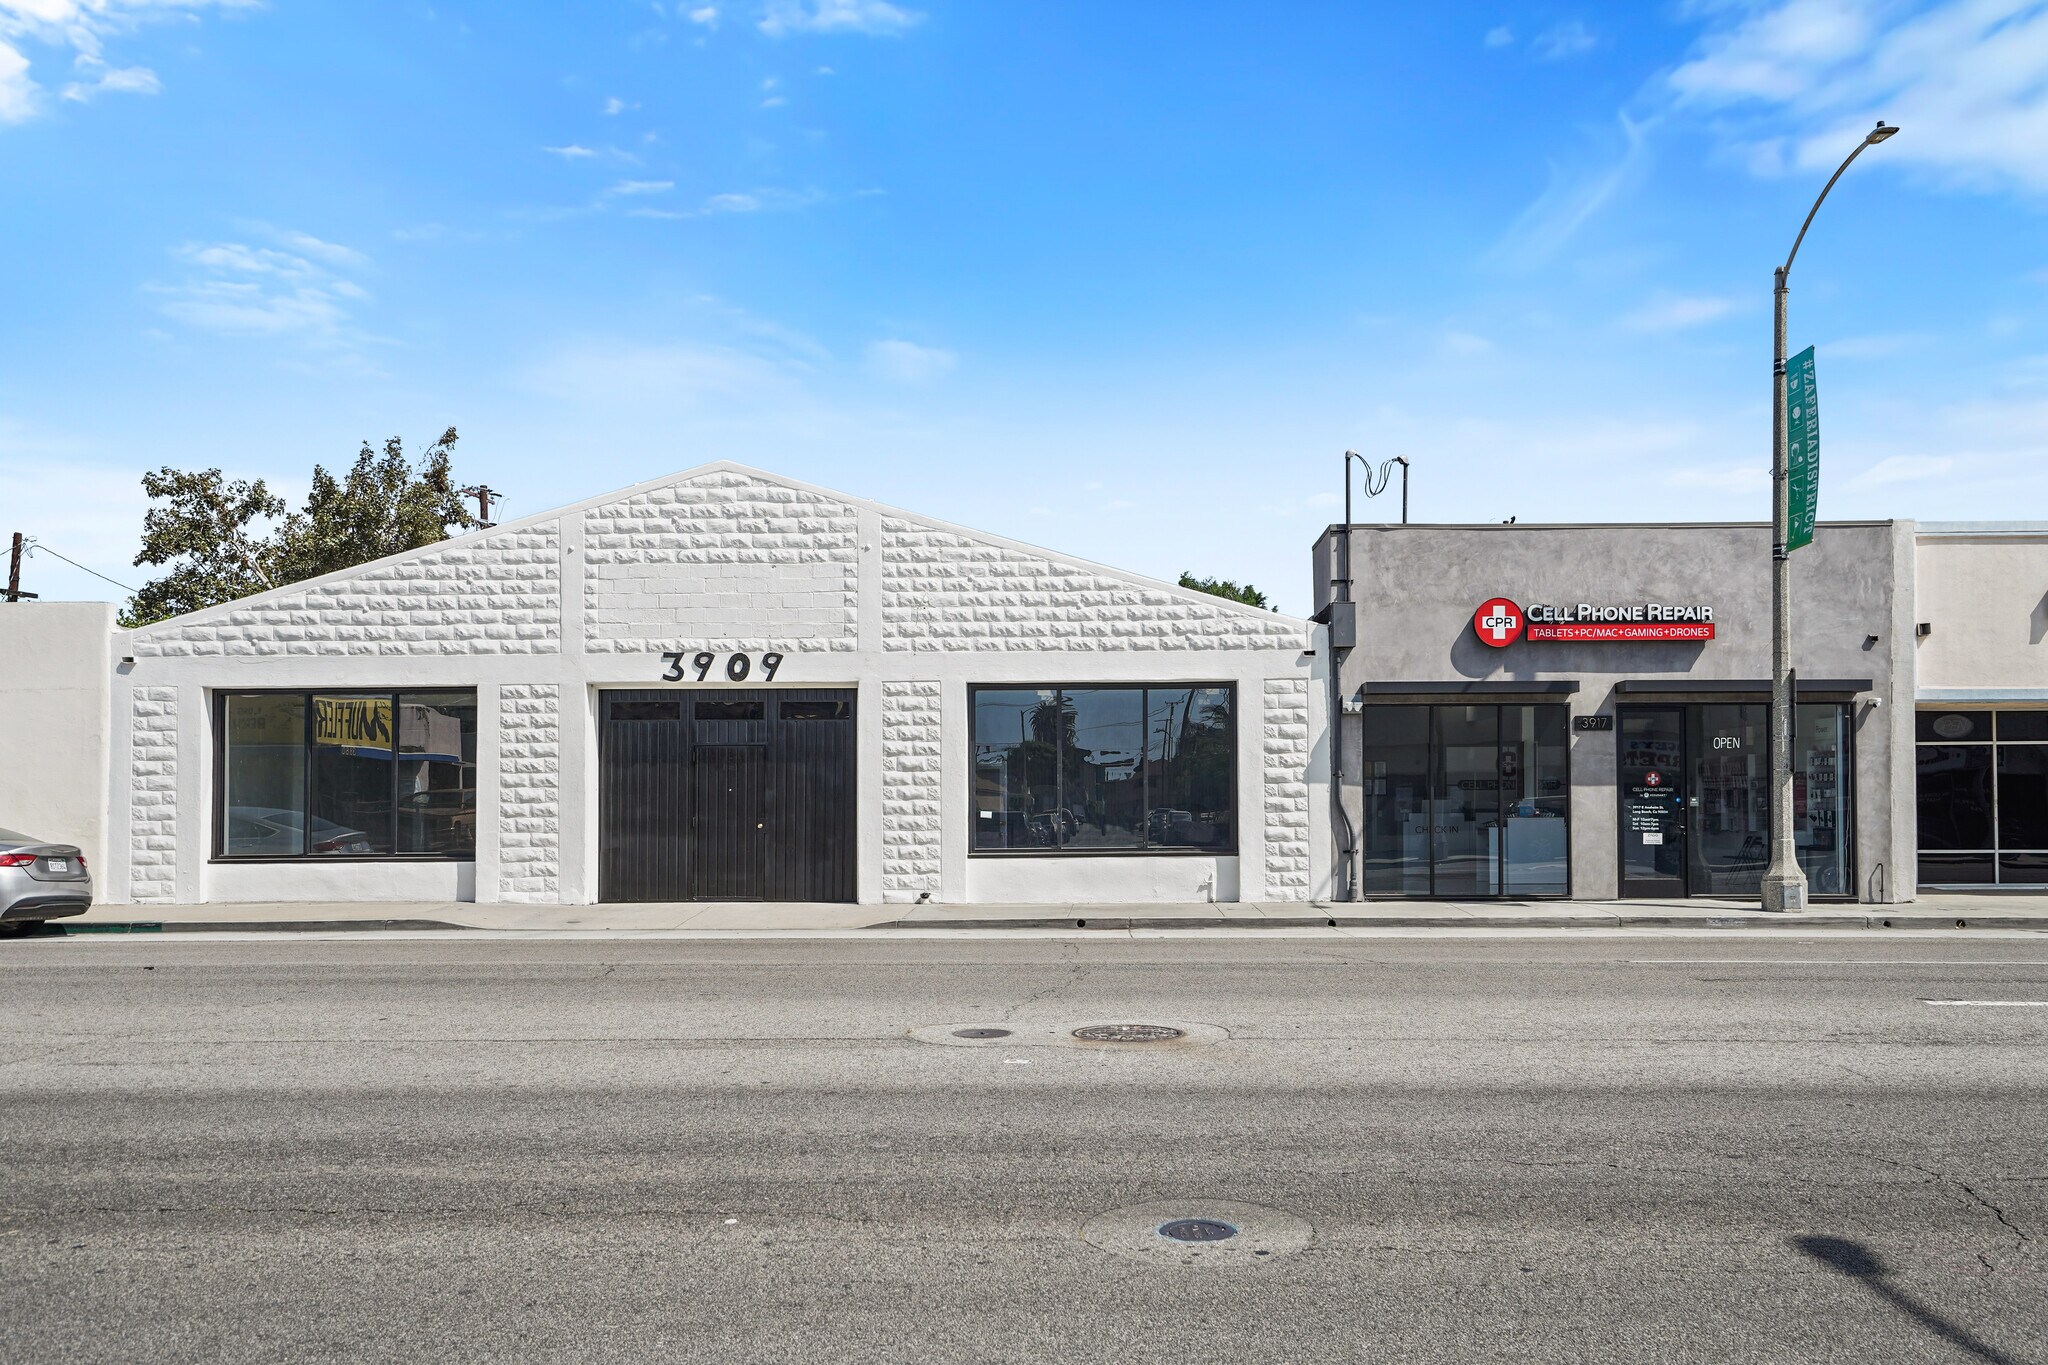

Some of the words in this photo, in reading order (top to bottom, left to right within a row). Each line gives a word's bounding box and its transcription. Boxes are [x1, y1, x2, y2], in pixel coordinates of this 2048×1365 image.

[1802, 359, 1819, 534] #ZAFERIADISTRICT
[1527, 603, 1574, 622] CELL
[1577, 603, 1644, 621] PHONE
[1647, 603, 1713, 621] REPAIR
[1485, 617, 1513, 628] CPR
[662, 651, 784, 682] 3909
[1581, 717, 1607, 729] 3917
[1713, 737, 1741, 749] OPEN
[1487, 781, 1516, 789] PHON
[1415, 826, 1447, 834] CHCK
